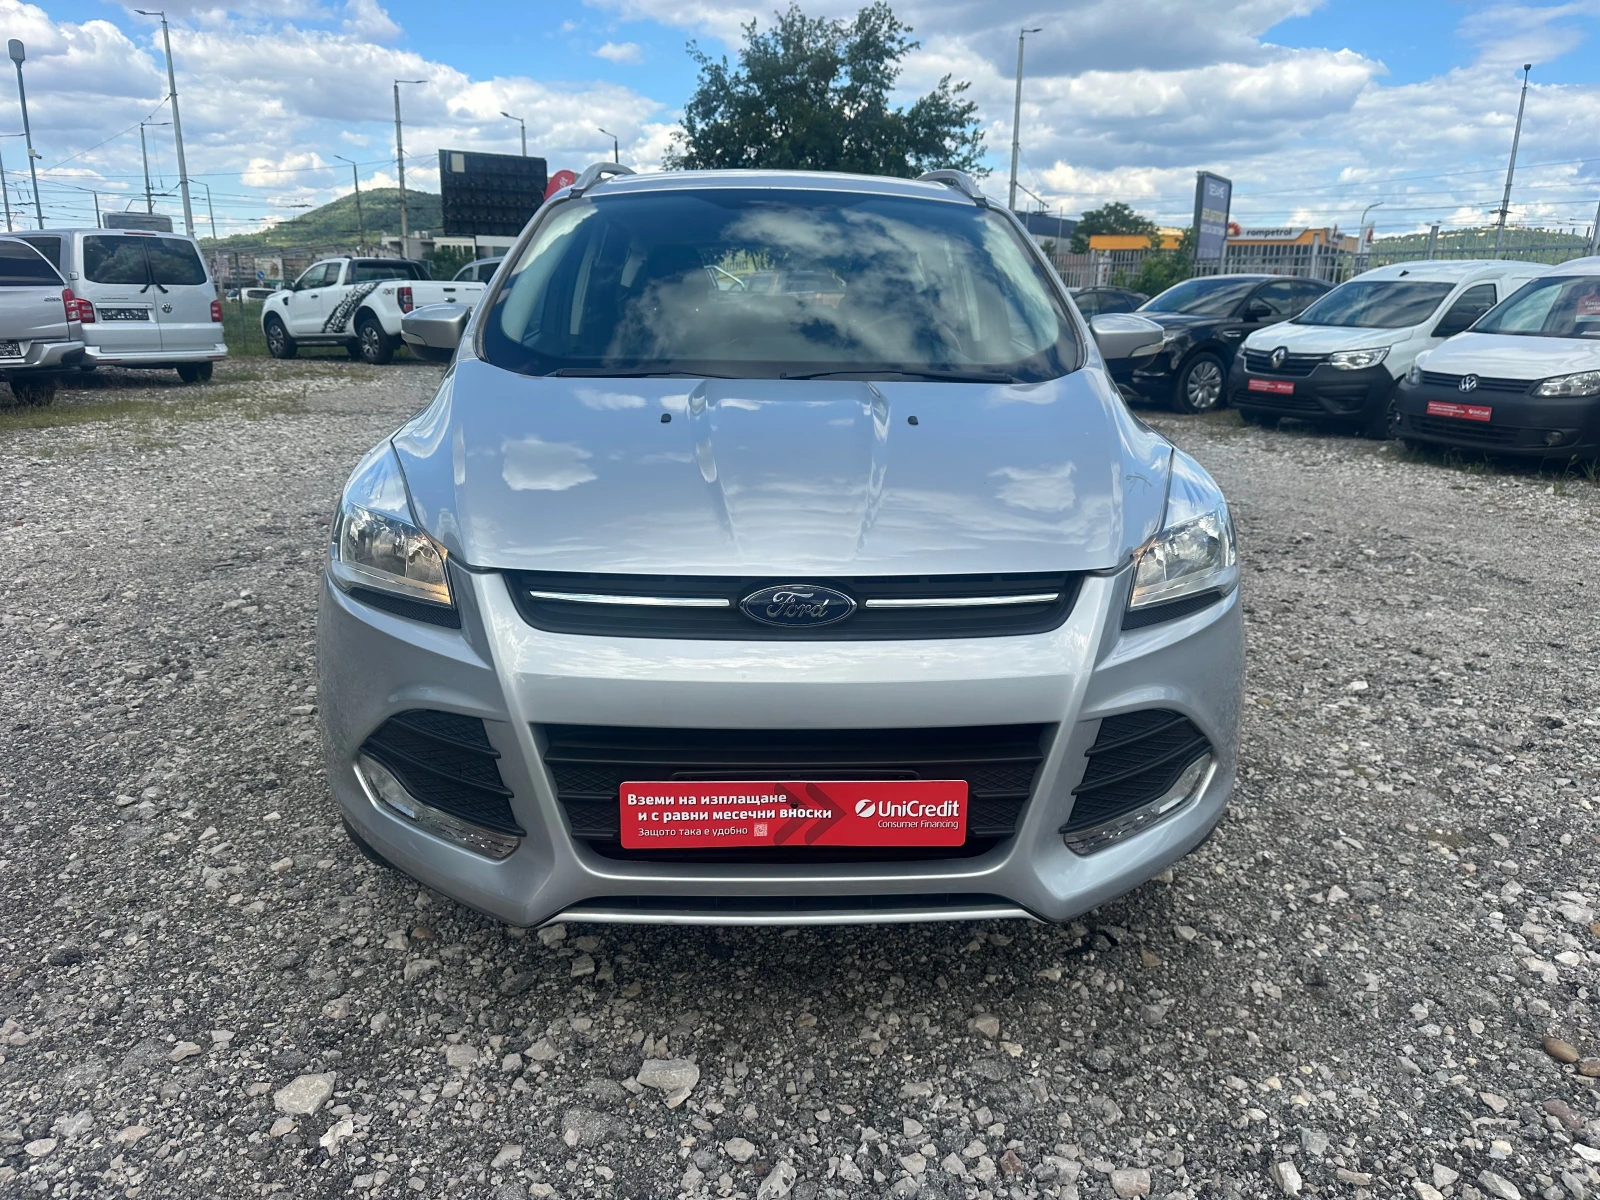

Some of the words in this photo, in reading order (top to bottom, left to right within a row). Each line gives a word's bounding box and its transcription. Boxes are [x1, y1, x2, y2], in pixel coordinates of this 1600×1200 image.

[1246, 228, 1293, 238] rompetrol
[766, 591, 830, 618] Ford
[627, 793, 675, 806] Вземи
[678, 795, 697, 805] на
[701, 794, 787, 806] изплащане
[878, 800, 960, 817] UniCredit
[638, 811, 647, 821] и
[651, 811, 659, 821] с
[663, 811, 709, 824] равни
[712, 809, 776, 820] месечни
[779, 808, 832, 819] вноски
[877, 820, 919, 828] Consumer
[920, 820, 959, 830] Financing
[638, 827, 677, 838] Защото
[678, 828, 702, 836] така
[703, 828, 710, 836] е
[712, 826, 748, 838] удобно
